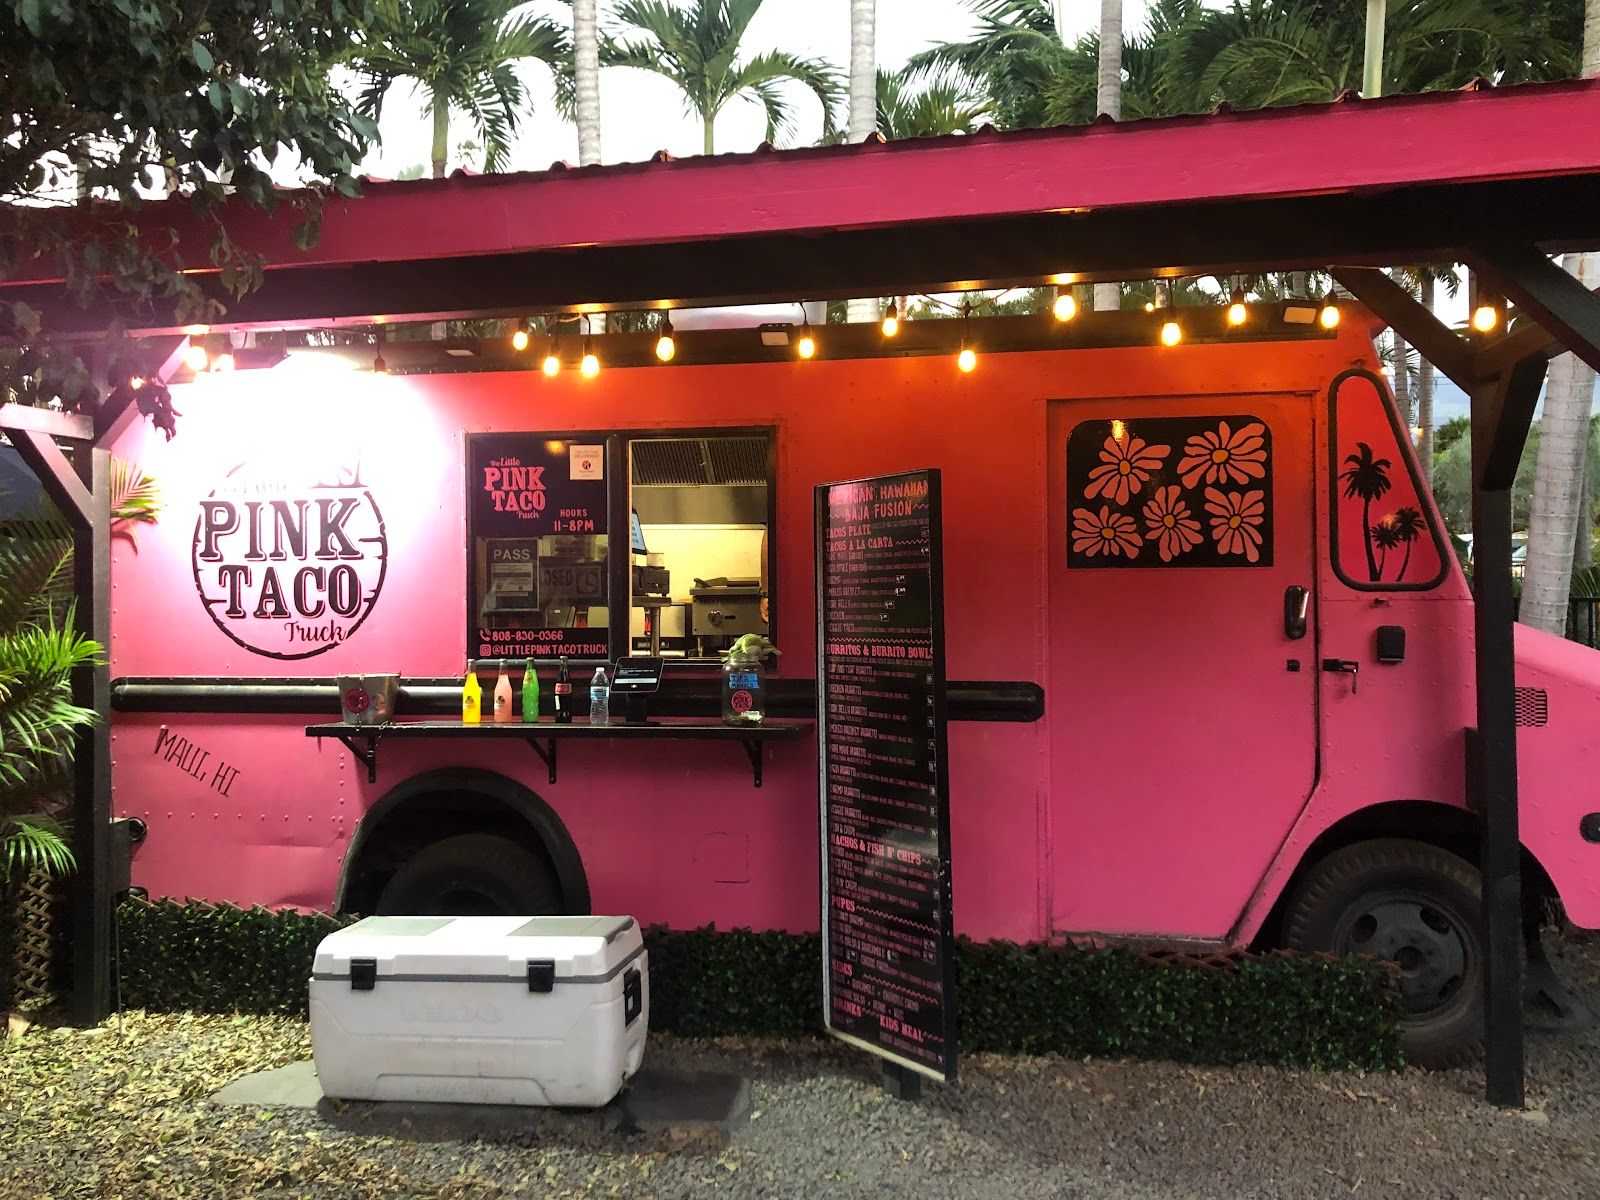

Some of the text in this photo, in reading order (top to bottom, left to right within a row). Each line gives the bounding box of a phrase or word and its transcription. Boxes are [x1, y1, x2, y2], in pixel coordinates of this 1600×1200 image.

[500, 457, 520, 466] Little
[484, 467, 546, 490] PINK
[492, 491, 545, 511] TACO
[874, 499, 912, 519] FUSION
[560, 509, 588, 517] HOURS
[199, 498, 364, 562] PINK
[554, 520, 594, 532] 11-8PM
[827, 527, 847, 539] TACOS
[848, 524, 872, 536] PLATE
[827, 540, 847, 552] TACOS
[856, 539, 866, 550] LA
[868, 537, 893, 549] CARTA
[493, 549, 530, 560] PASS
[218, 564, 362, 619] TACO
[284, 620, 349, 642] Truck
[492, 631, 563, 641] 808-830-0366
[492, 644, 608, 656] @LITTLEPINKTACOTRUCK
[826, 644, 861, 656] BURRITOS
[863, 646, 869, 656] &
[871, 646, 906, 658] BURRITO
[155, 728, 240, 797] MAUI, HI
[867, 842, 884, 857] FISH
[897, 849, 921, 865] CHIPS
[831, 895, 855, 912] PUPUS
[880, 1014, 924, 1043] KIDS MEAL
